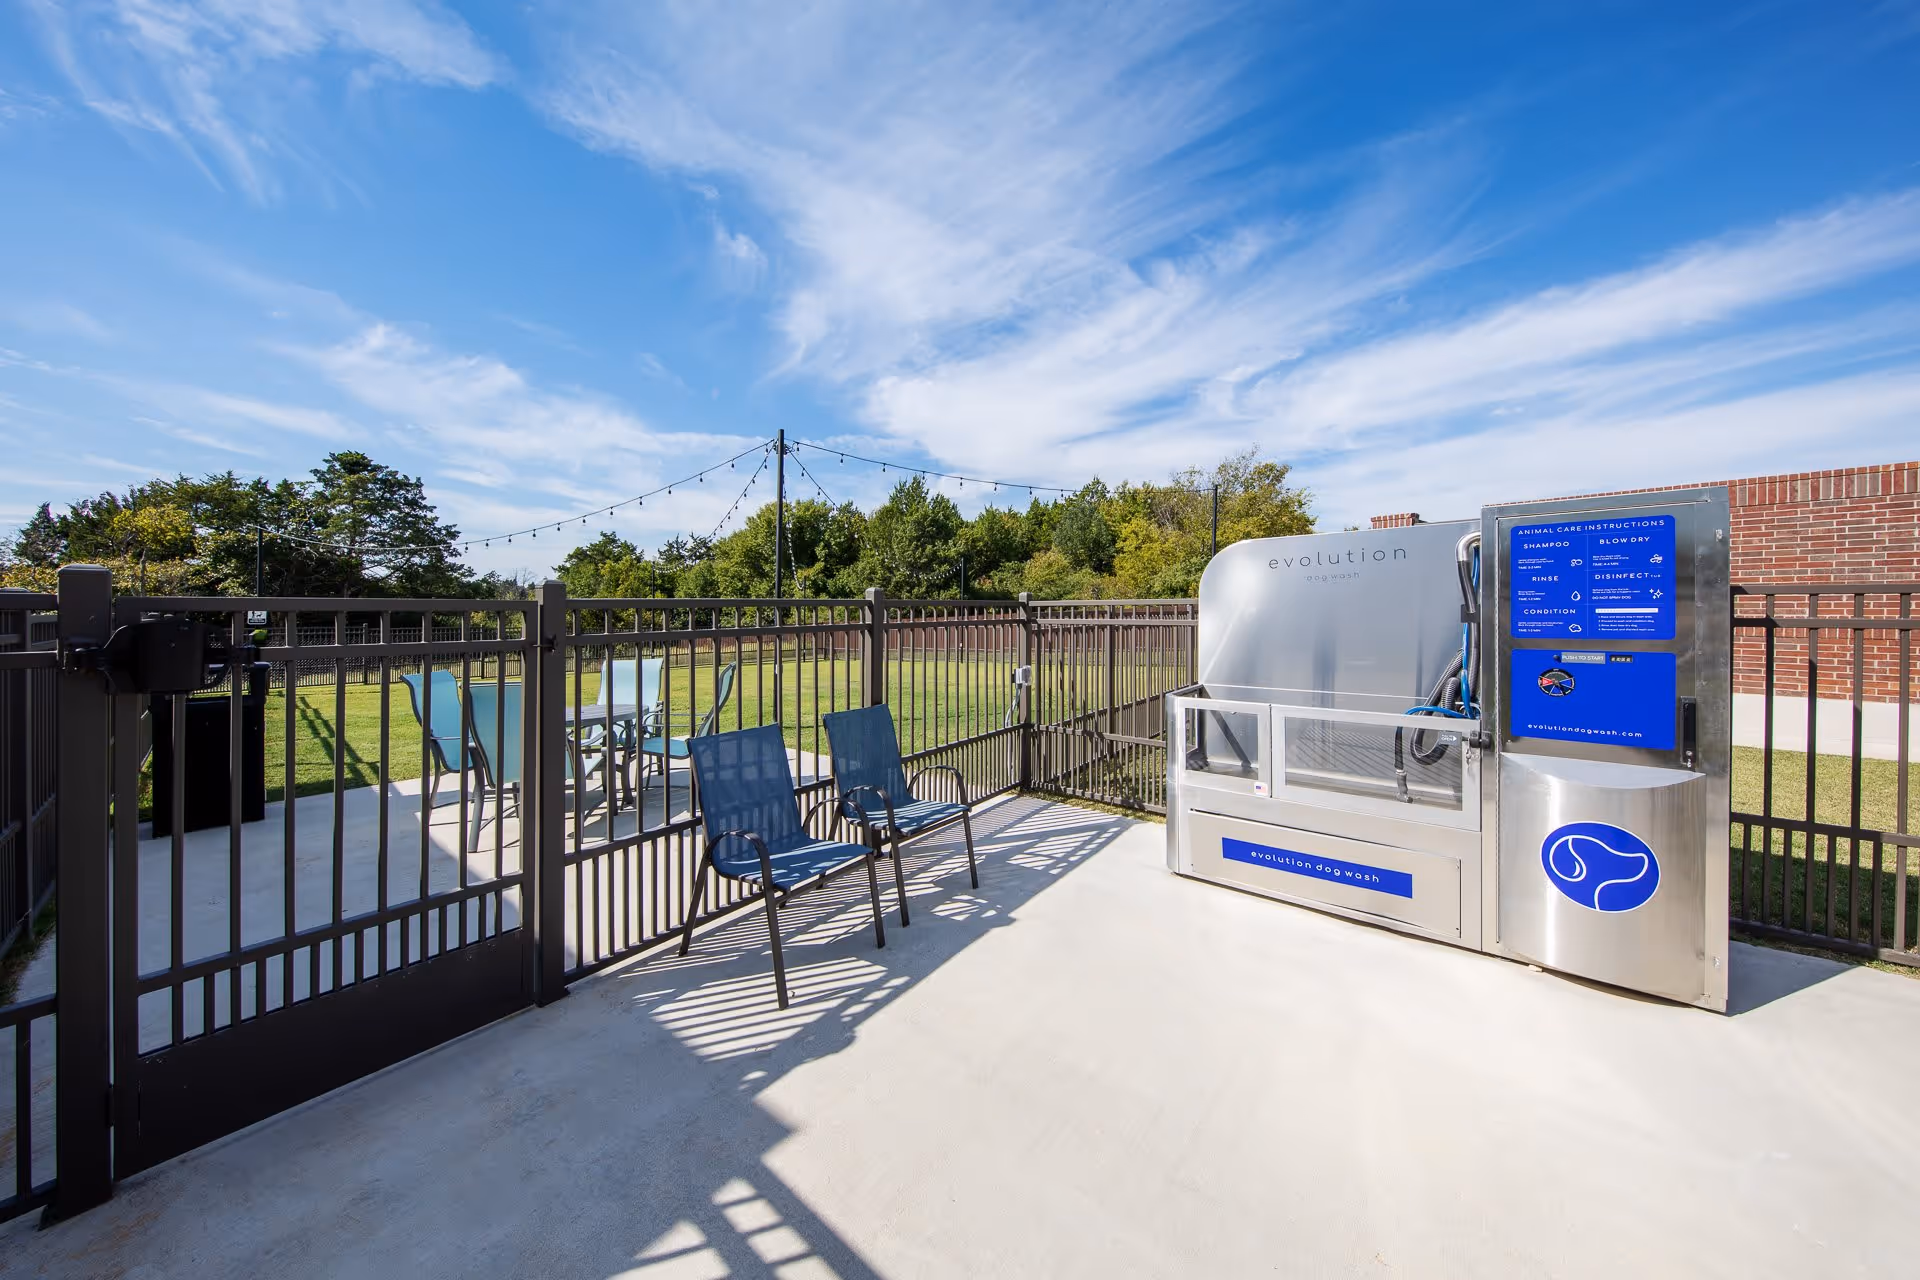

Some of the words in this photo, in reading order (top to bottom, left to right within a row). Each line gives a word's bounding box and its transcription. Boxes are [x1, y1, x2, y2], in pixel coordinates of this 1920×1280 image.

[1584, 519, 1665, 531] INSTRUCTIONS
[1523, 541, 1570, 549] SHAMPOO
[1268, 547, 1407, 569] evolution
[1331, 571, 1360, 580] wash
[1594, 572, 1649, 580] DISINFECT
[1527, 723, 1642, 738] evolutiondogwash.com
[1250, 850, 1312, 869] evolution
[1315, 863, 1341, 876] dog
[1344, 868, 1380, 883] wash
